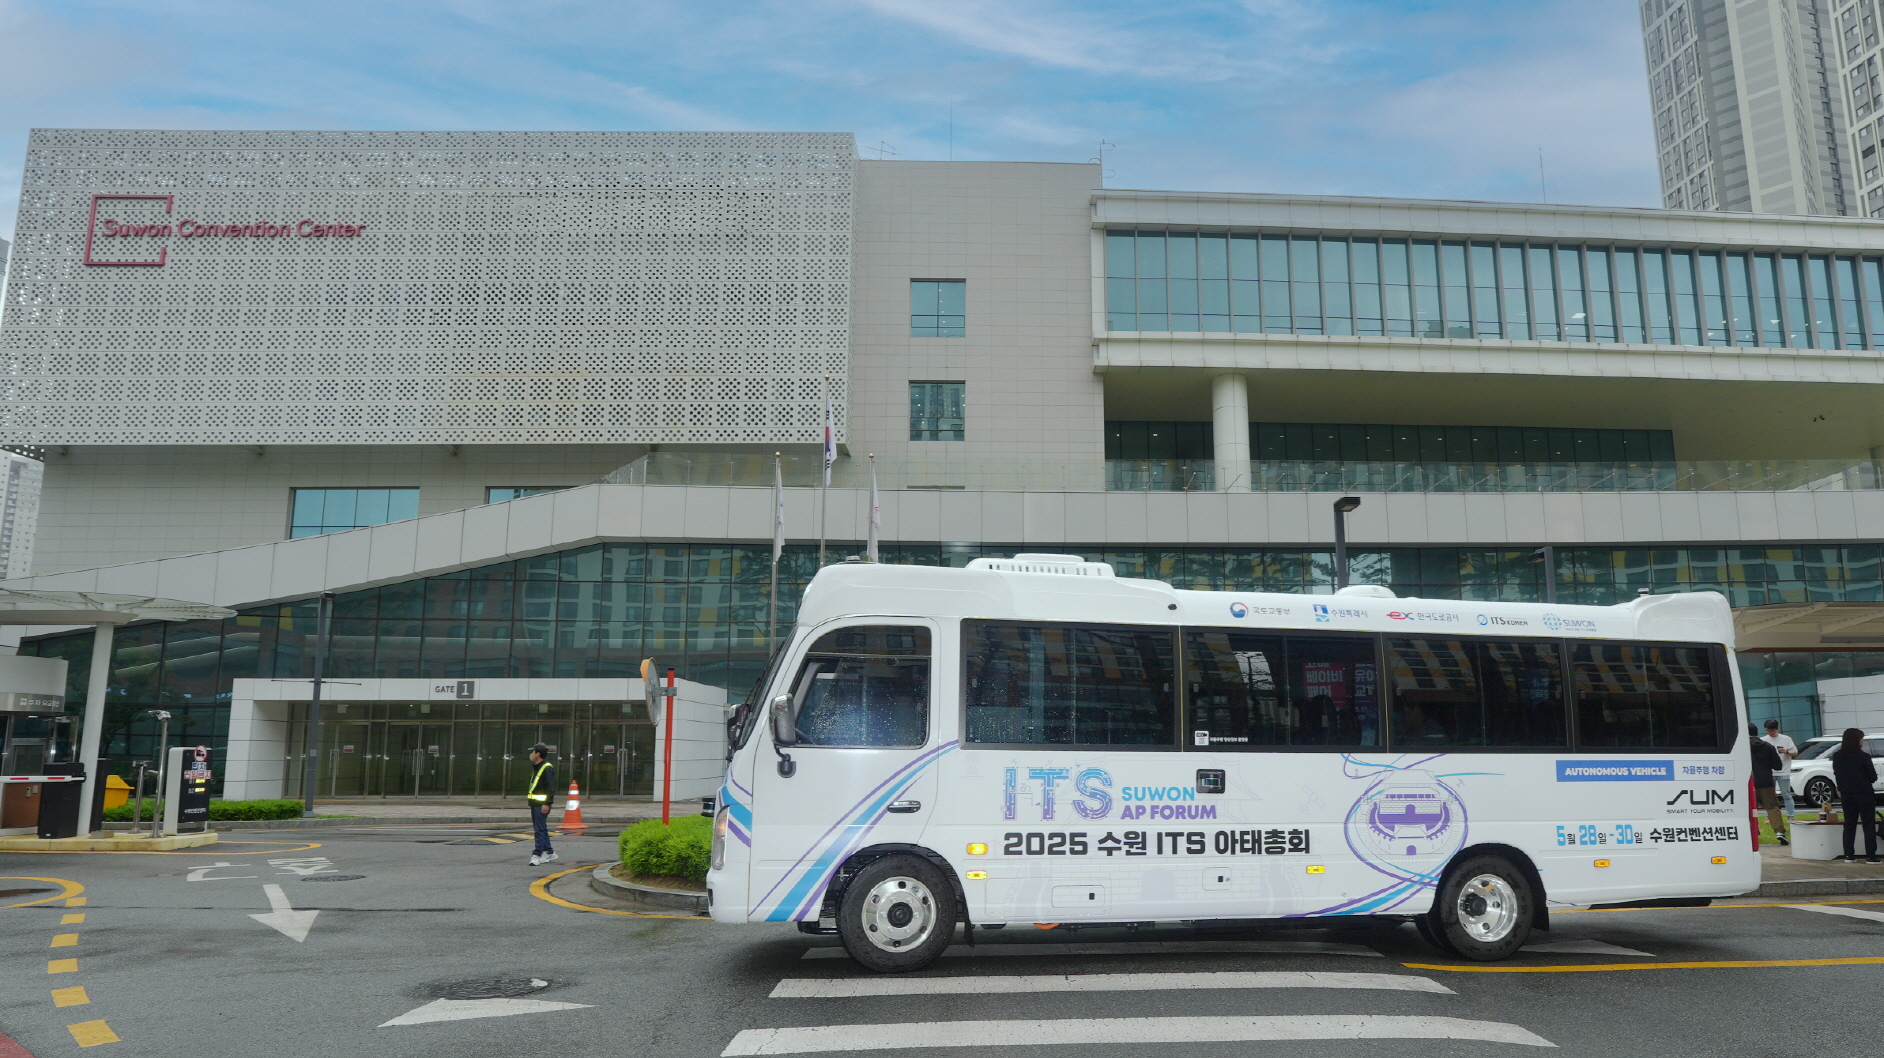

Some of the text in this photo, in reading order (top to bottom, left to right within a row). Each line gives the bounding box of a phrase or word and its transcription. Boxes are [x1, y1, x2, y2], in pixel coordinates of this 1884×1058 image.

[102, 219, 366, 238] Suwon Convention Center
[1331, 609, 1368, 618] 수원특례시
[1562, 619, 1597, 628] SUWON
[434, 683, 469, 696] GATE 1
[1565, 767, 1666, 776] AUTONOMOUS VEHICLE
[1682, 765, 1725, 775] 자율주행 차량
[1002, 766, 1114, 821] ITS
[1121, 786, 1195, 802] SUWON
[1666, 789, 1734, 805] SUM
[1120, 804, 1217, 820] AP FORUM
[1003, 828, 1311, 856] 2025 수원 ITS 아태총회
[1649, 826, 1739, 843] 수원컨벤션센터
